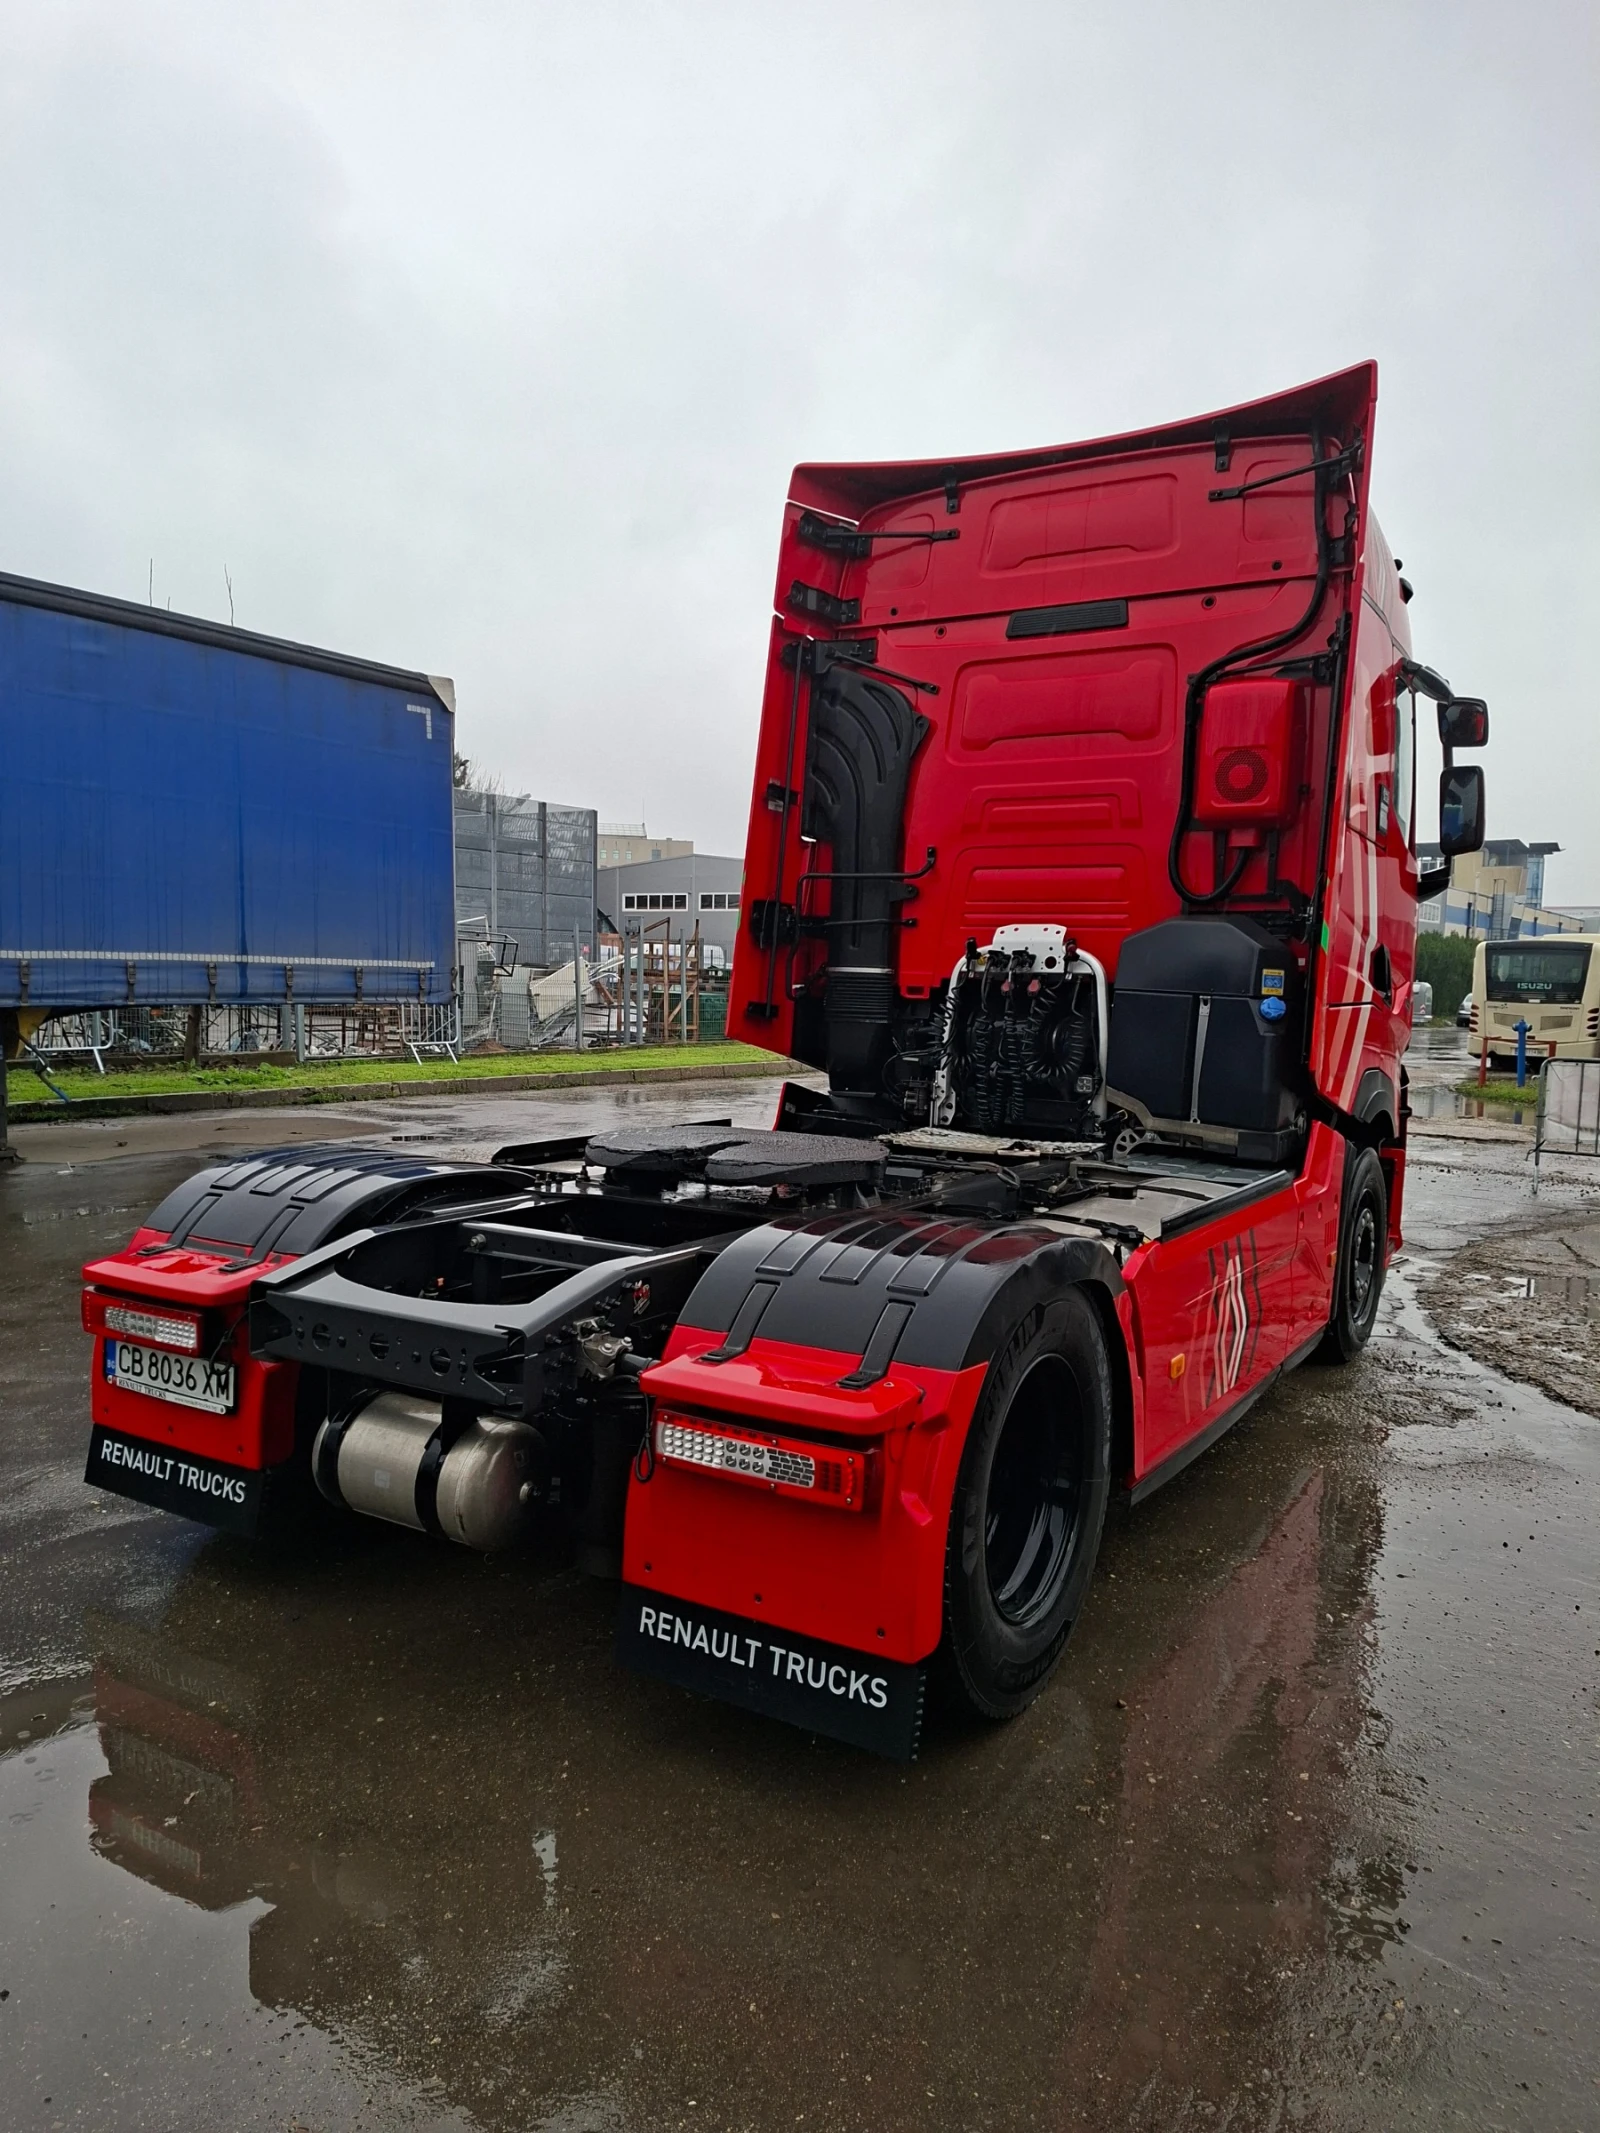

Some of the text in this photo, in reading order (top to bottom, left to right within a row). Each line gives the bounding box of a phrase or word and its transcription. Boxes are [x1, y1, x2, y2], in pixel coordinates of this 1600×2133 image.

[1517, 982, 1552, 990] ISUZU
[107, 1359, 116, 1370] BG
[119, 1344, 230, 1401] CB 8036 XM
[118, 1377, 167, 1400] RENAULT TRUCKS
[101, 1439, 247, 1503] RENAULT TRUCKS
[639, 1606, 888, 1708] RENAULT TRUCKS
